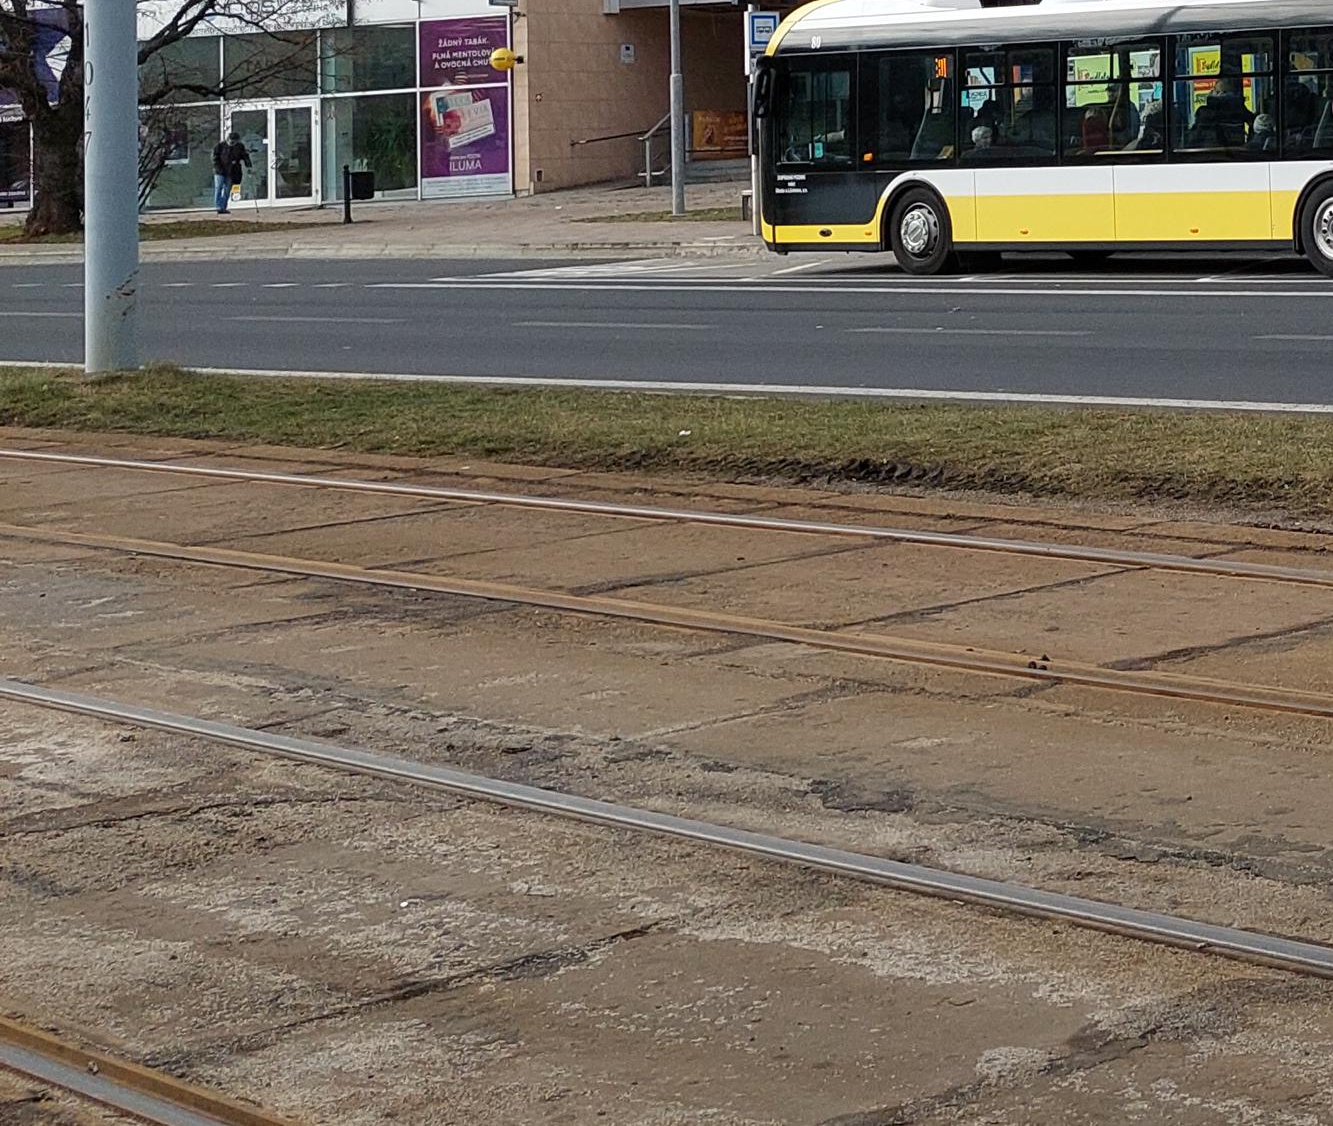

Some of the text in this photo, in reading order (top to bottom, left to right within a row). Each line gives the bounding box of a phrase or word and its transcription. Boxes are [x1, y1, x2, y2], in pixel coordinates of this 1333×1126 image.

[438, 37, 462, 48] ŽÁDNÝ
[432, 48, 494, 60] PLNÁ MENTOLOV
[441, 57, 472, 69] OVOCNÁ
[473, 58, 491, 66] CHU
[449, 159, 482, 172] ILUMA
